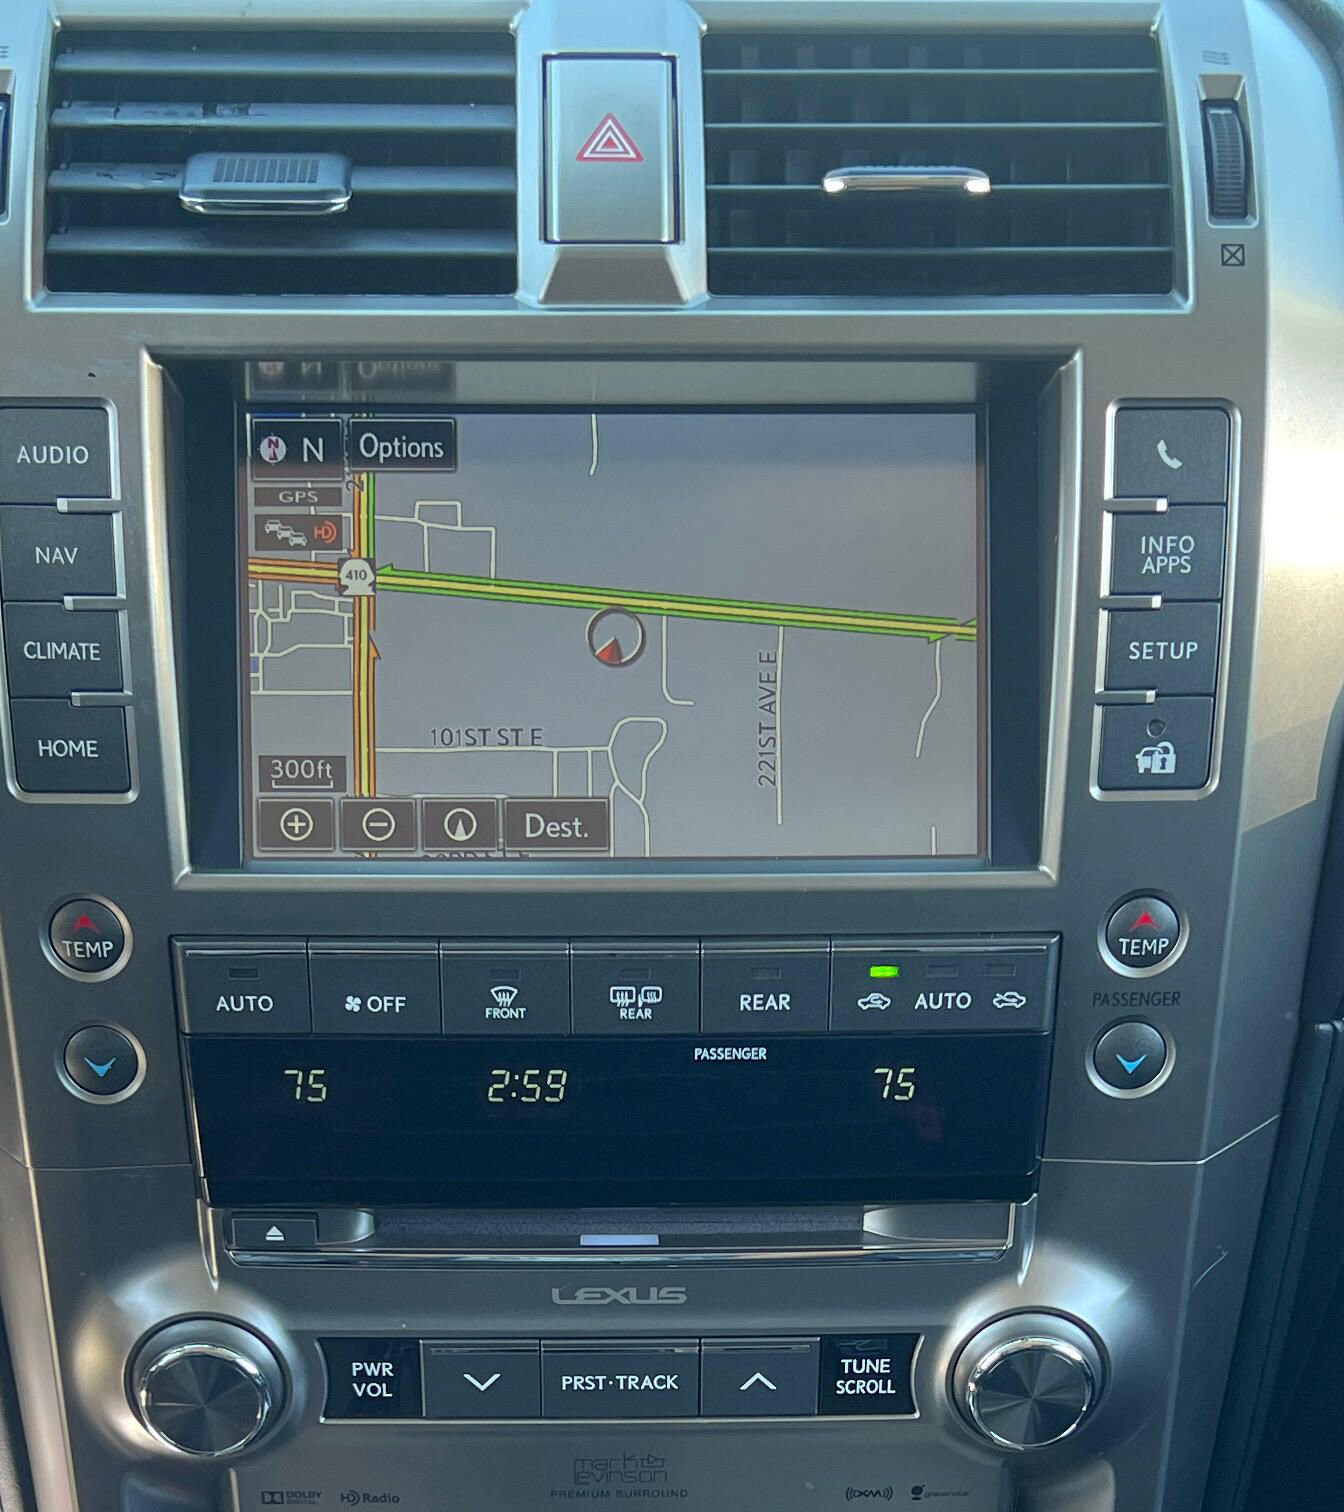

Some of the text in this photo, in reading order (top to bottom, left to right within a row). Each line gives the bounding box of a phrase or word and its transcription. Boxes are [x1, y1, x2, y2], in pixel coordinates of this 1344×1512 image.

[16, 445, 90, 465] AUDIO
[302, 436, 325, 463] N
[359, 432, 444, 464] Options
[278, 490, 319, 504] GPS
[1140, 535, 1195, 554] INFO
[34, 546, 79, 565] NAV
[1141, 555, 1192, 574] APPS
[346, 569, 368, 581] 410
[23, 640, 102, 661] CLIMATE
[1128, 641, 1199, 661] SETUP
[757, 651, 777, 787] 221ST AVE E
[430, 727, 544, 748] 101ST ST E
[38, 739, 99, 758] HOME
[270, 759, 334, 779] 300ft
[525, 812, 589, 839] Dest.
[61, 940, 114, 959] TEMP
[1118, 937, 1169, 956] TEMP
[215, 995, 274, 1013] AUTO
[366, 995, 407, 1013] OFF
[739, 993, 791, 1012] REAR
[914, 992, 972, 1010] AUTO
[1091, 991, 1182, 1008] PASSENGER
[485, 1007, 527, 1020] FRONT
[619, 1007, 653, 1020] REAR
[693, 1046, 768, 1061] PASSENGER
[283, 1068, 329, 1103] 75
[487, 1068, 568, 1103] 2:59
[873, 1067, 916, 1101] 75
[551, 1285, 688, 1306] LEXUS
[351, 1361, 394, 1378] PWR
[840, 1357, 892, 1375] TUNE
[352, 1382, 393, 1399] VOL
[835, 1378, 897, 1396] SCROLL
[286, 1490, 323, 1499] DOLBY
[362, 1492, 401, 1505] Radio
[550, 1488, 689, 1499] PREMIUM SURROUND
